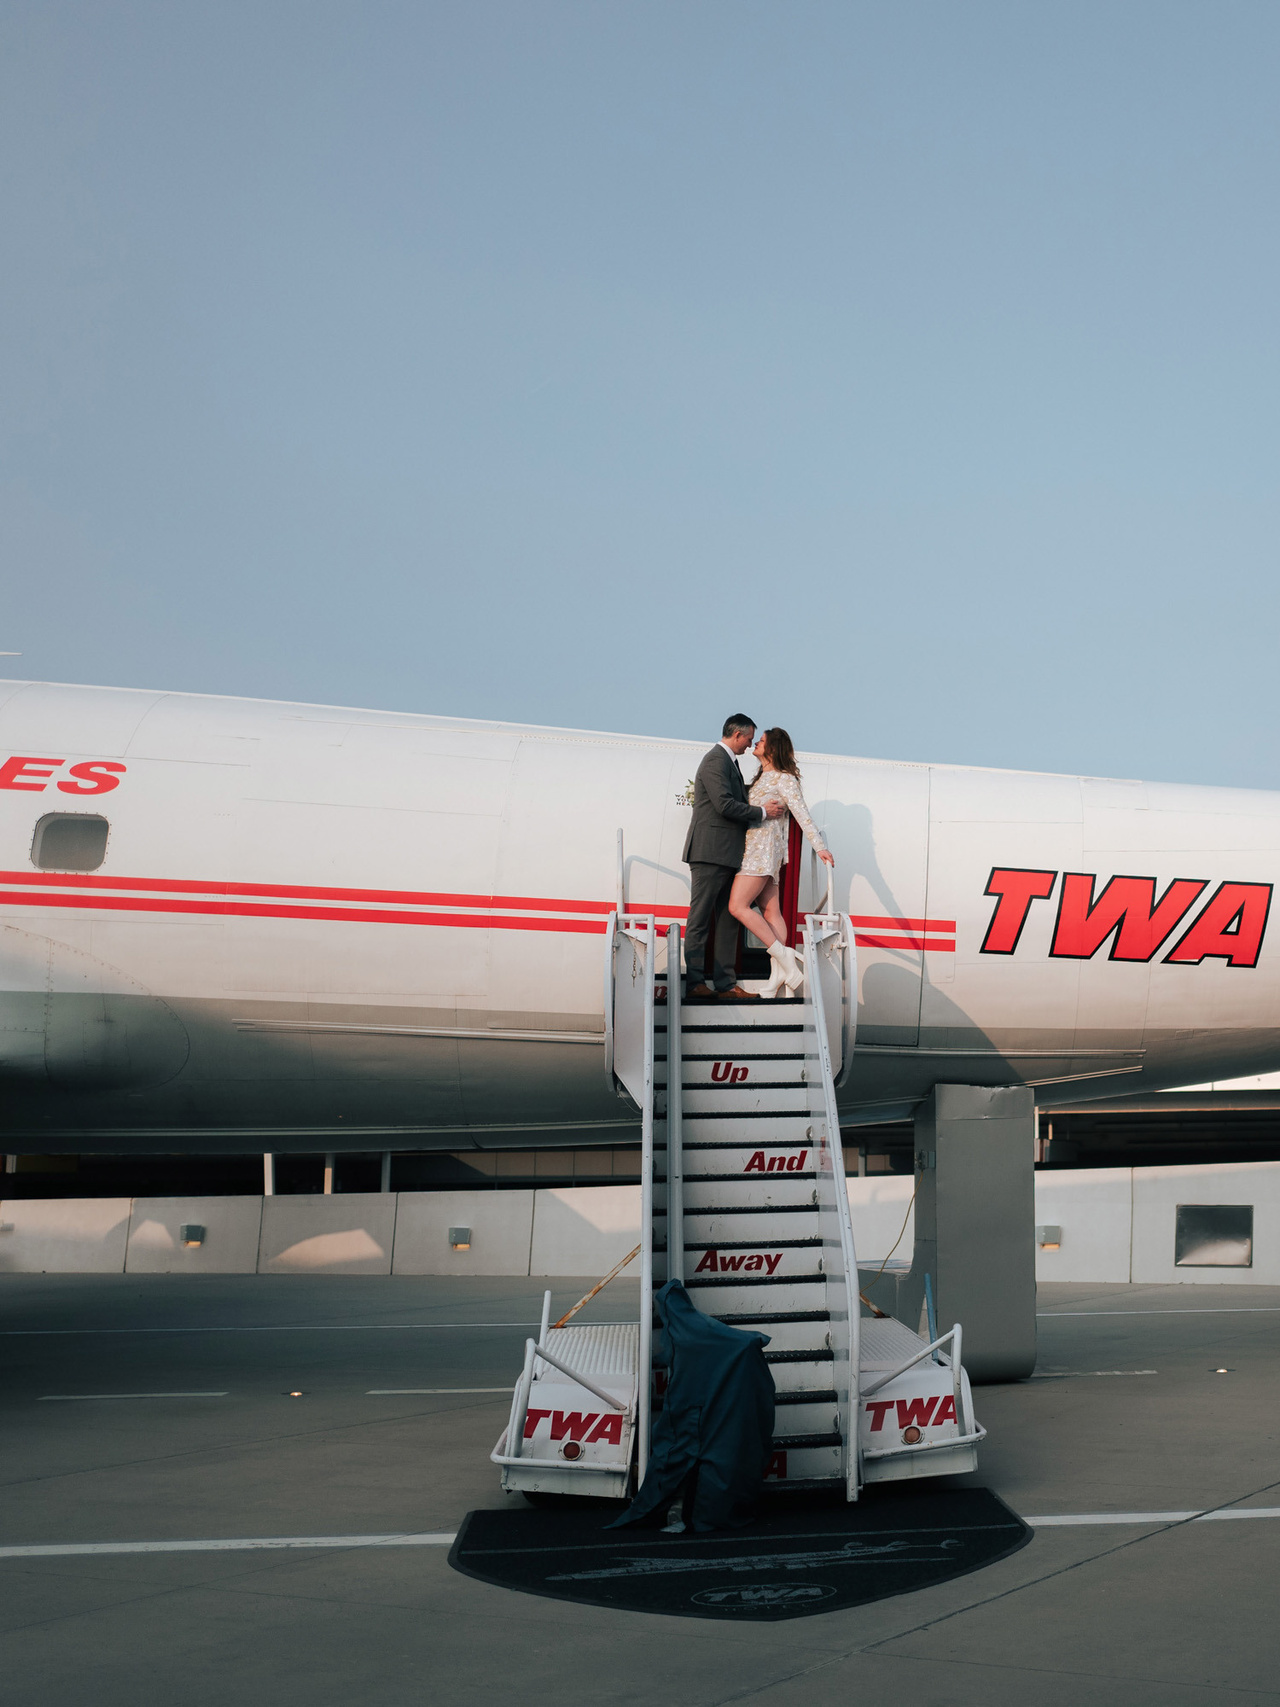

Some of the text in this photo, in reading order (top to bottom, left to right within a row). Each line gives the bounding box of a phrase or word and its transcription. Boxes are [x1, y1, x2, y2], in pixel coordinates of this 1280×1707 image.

[0, 756, 127, 795] ES
[979, 867, 1274, 969] TWA
[711, 1062, 749, 1083] Up
[743, 1150, 808, 1173] And
[694, 1249, 783, 1275] Away
[523, 1408, 623, 1445] TWA
[865, 1394, 958, 1432] TWA
[704, 1588, 824, 1602] TWA
